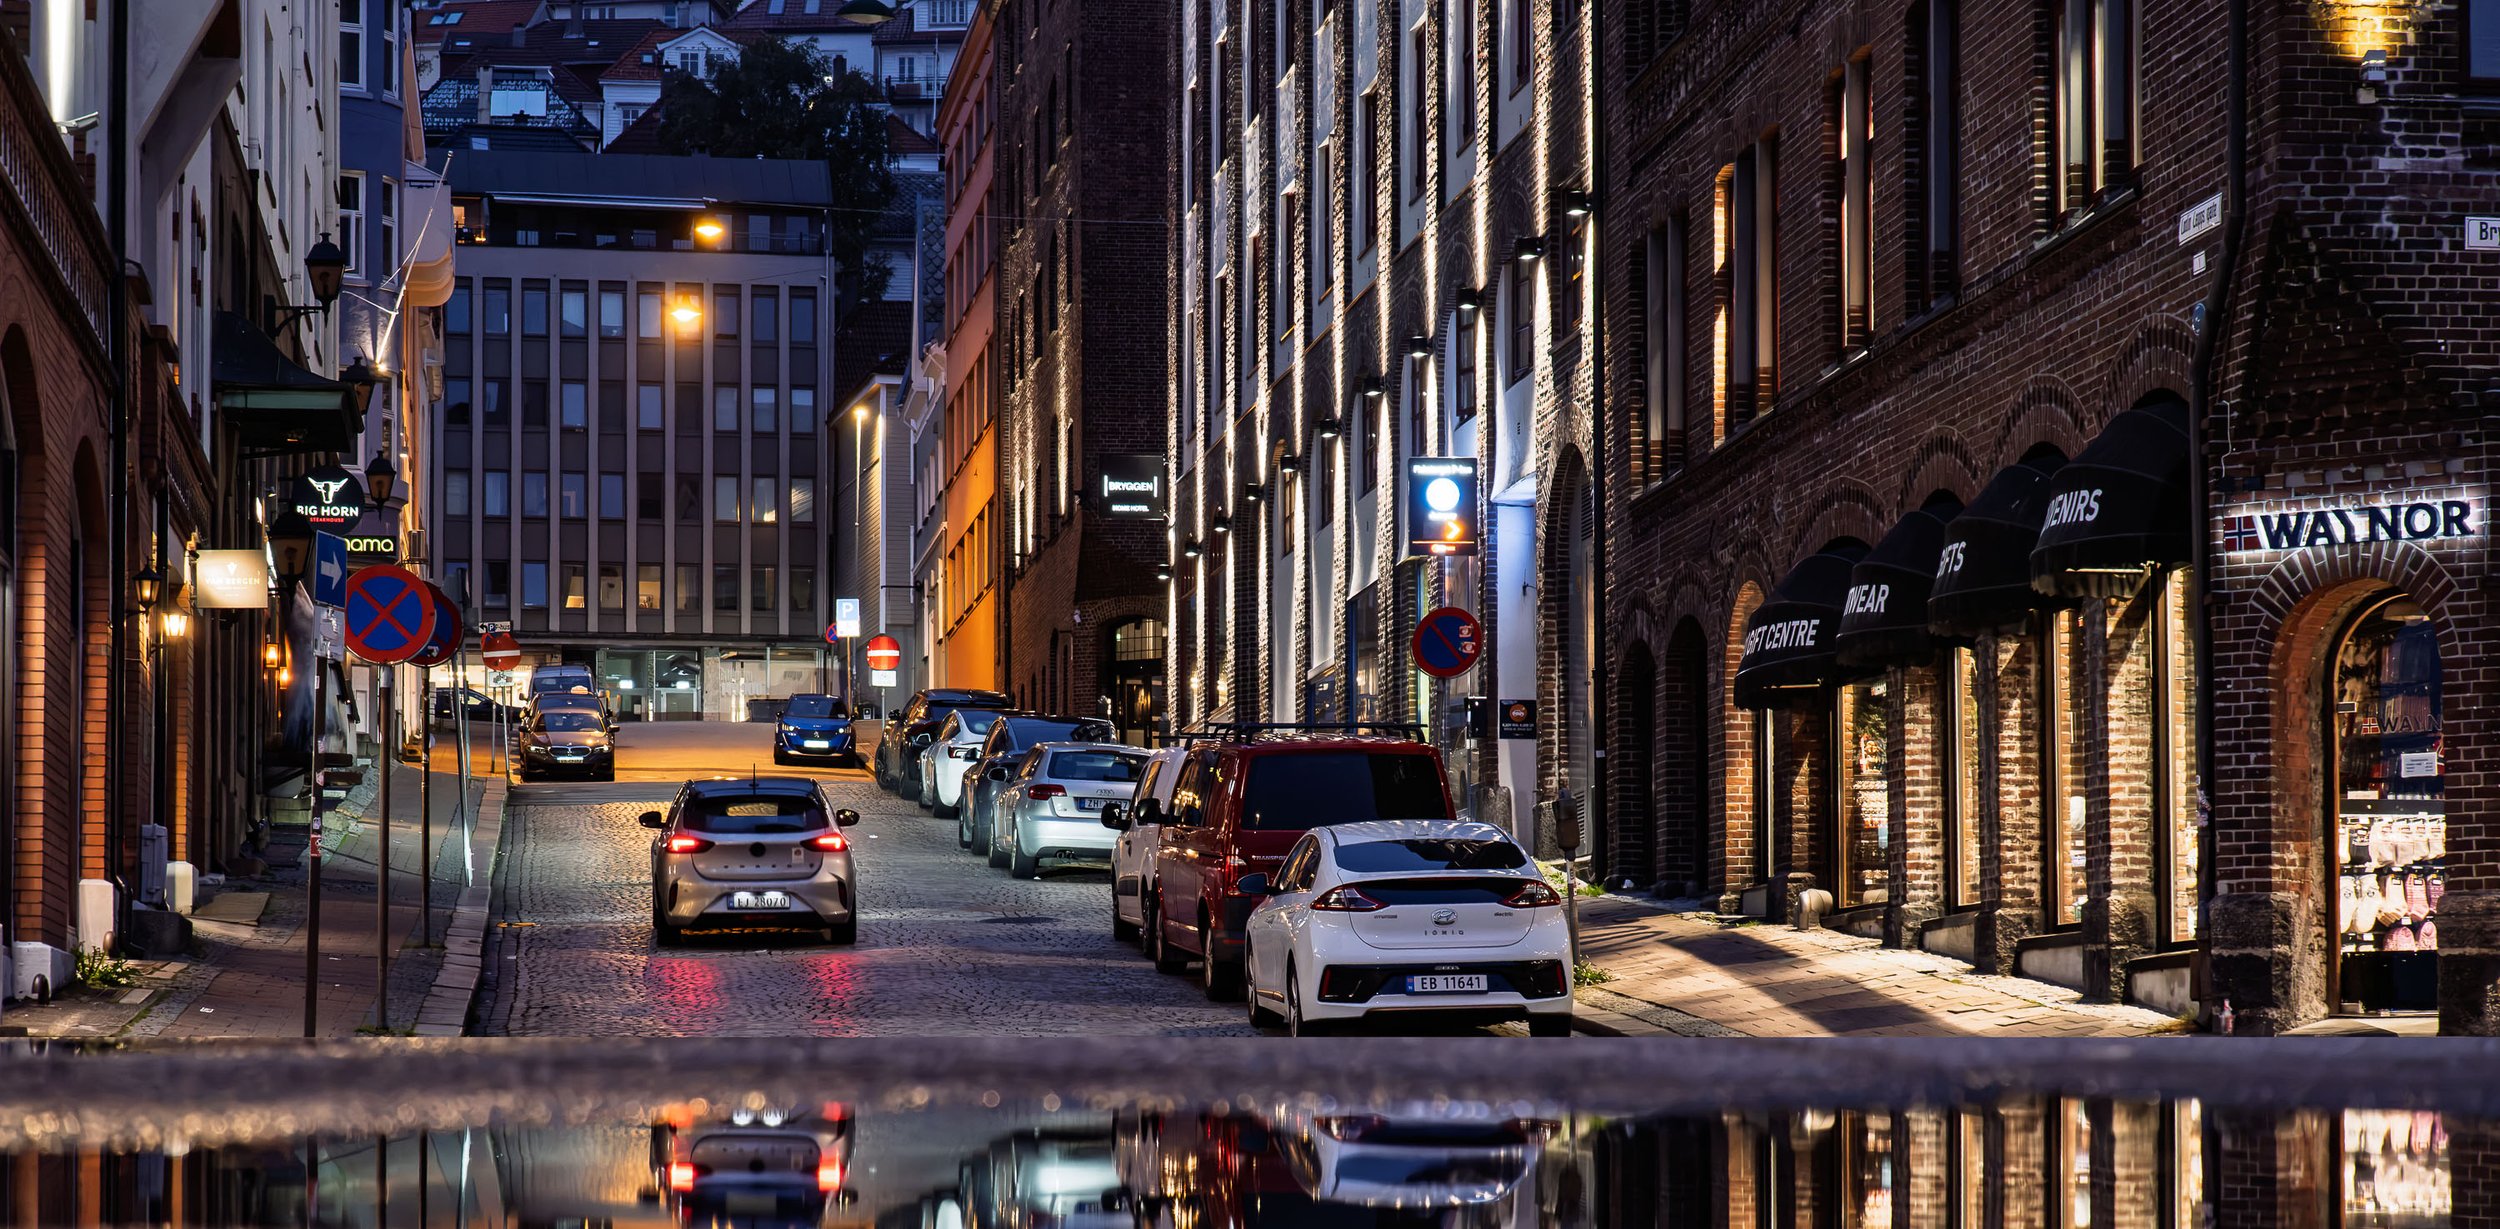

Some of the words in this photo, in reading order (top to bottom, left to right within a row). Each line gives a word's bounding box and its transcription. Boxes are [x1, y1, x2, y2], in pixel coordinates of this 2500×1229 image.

[1109, 481, 1153, 492] BRYGGEN
[297, 505, 318, 516] BIG
[321, 506, 358, 517] HORN
[1131, 504, 1149, 512] HOTEL
[843, 602, 853, 618] P
[1765, 619, 1820, 650] CENTRE
[1421, 976, 1437, 990] EB
[1444, 976, 1481, 990] 11641
